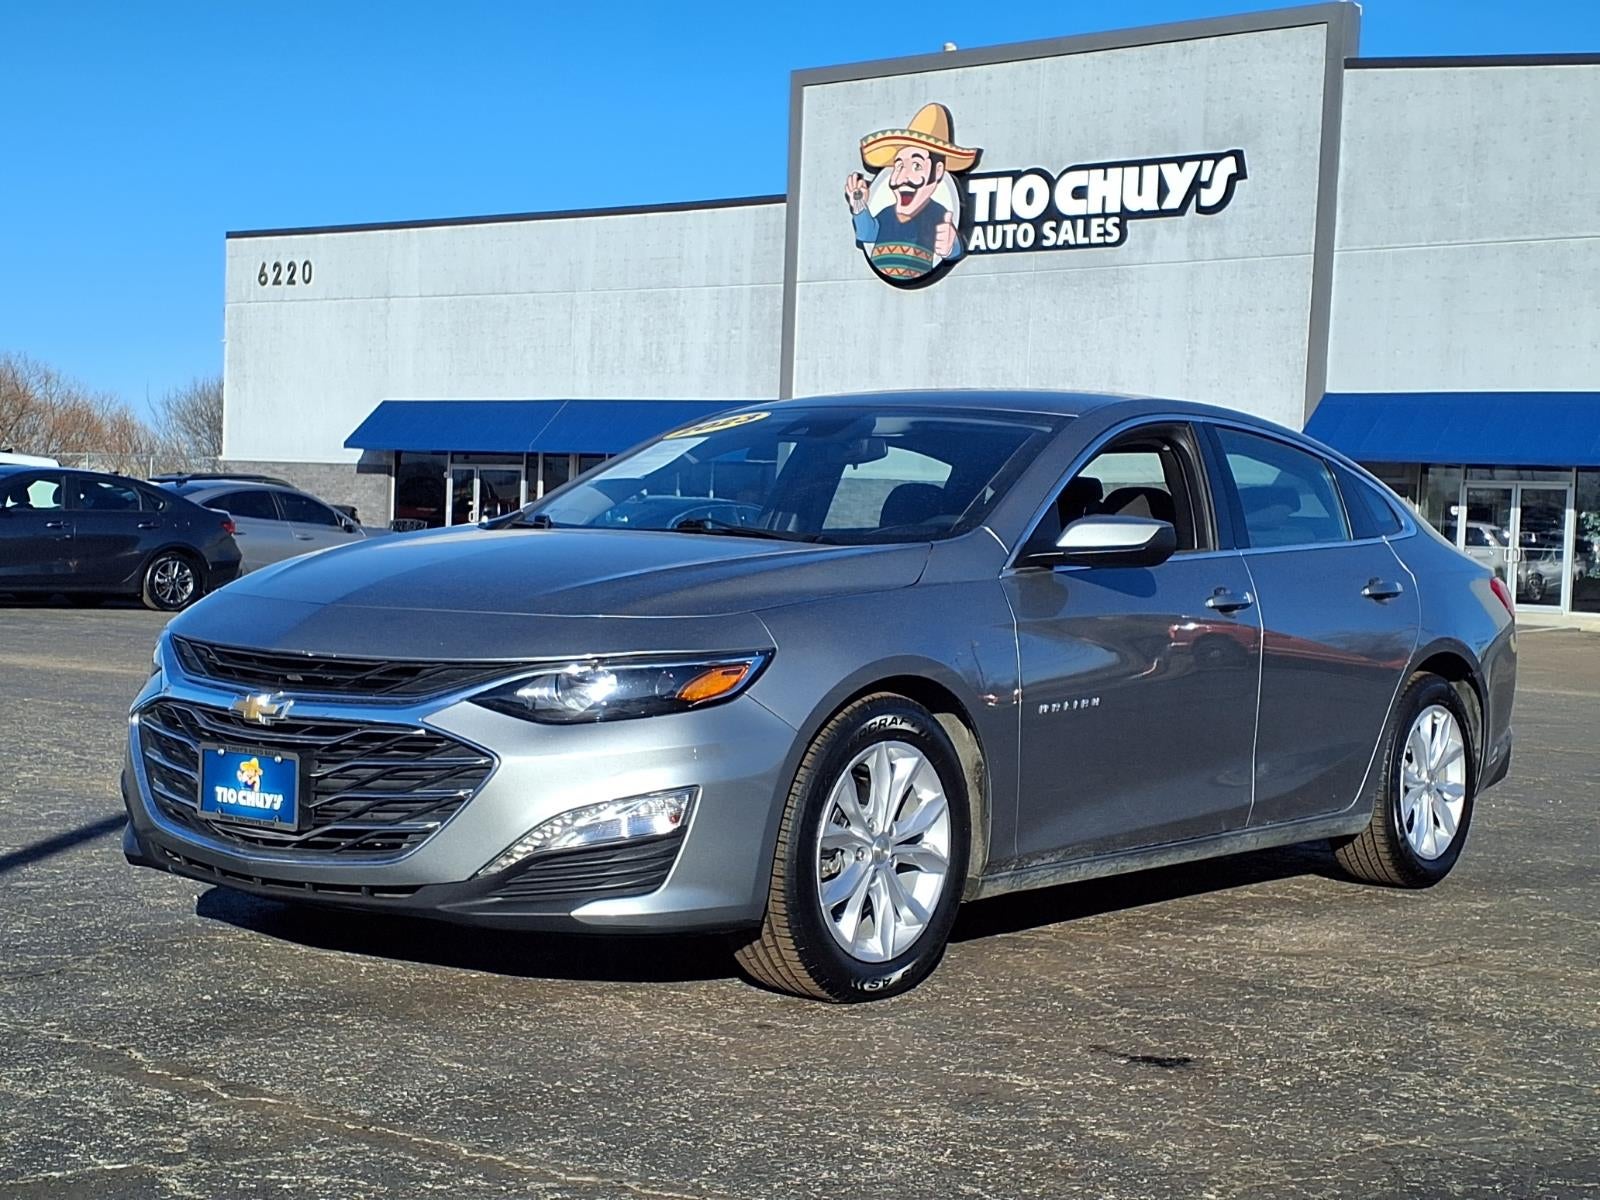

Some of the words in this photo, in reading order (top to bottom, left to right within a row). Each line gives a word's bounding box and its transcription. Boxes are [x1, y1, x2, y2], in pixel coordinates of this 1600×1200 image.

[968, 173, 1049, 223] TIO
[1055, 155, 1237, 217] CHUY'S
[968, 221, 1036, 251] AUTO
[1043, 217, 1121, 247] SALES
[257, 259, 313, 286] 6220
[215, 786, 238, 804] TIO
[238, 790, 284, 811] CHUY'S
